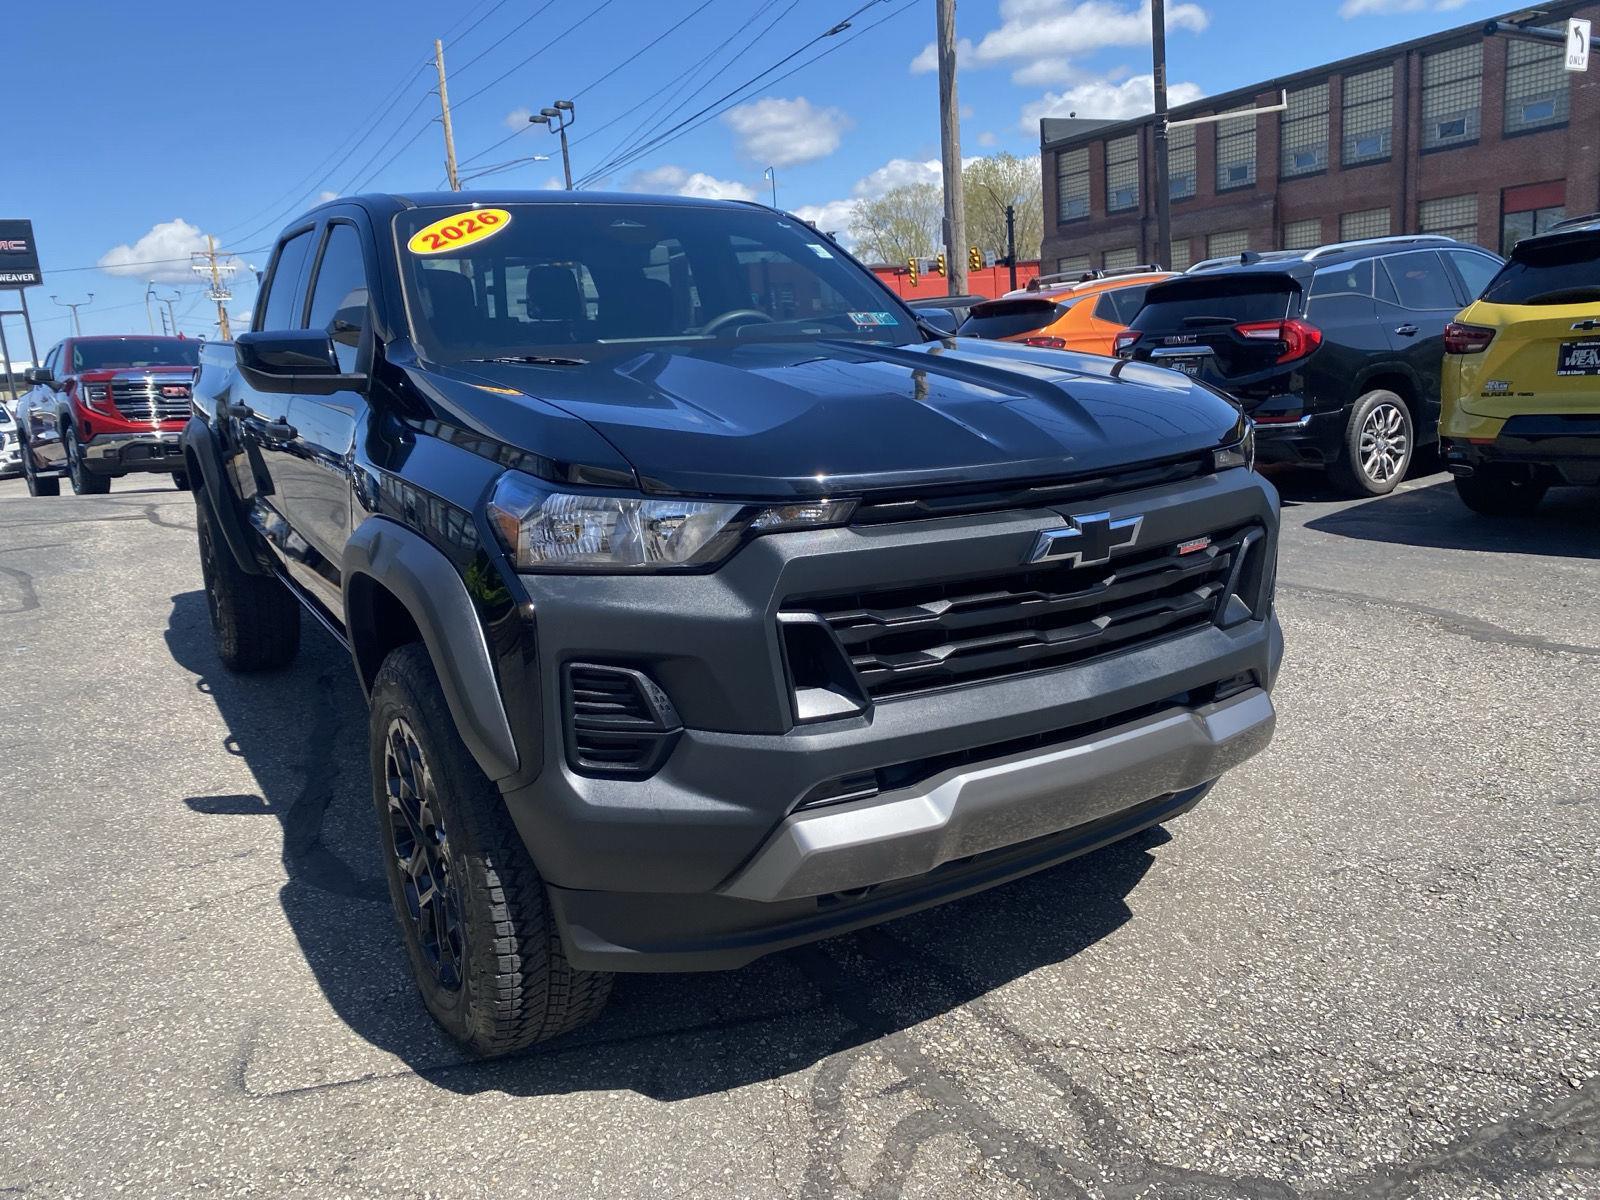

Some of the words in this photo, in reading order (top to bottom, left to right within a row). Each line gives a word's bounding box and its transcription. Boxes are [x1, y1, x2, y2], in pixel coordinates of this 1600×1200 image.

[1569, 54, 1585, 65] ONLY
[422, 212, 498, 250] 2026
[0, 240, 27, 250] MC
[1163, 335, 1197, 345] GMC
[1565, 356, 1600, 366] WEAV
